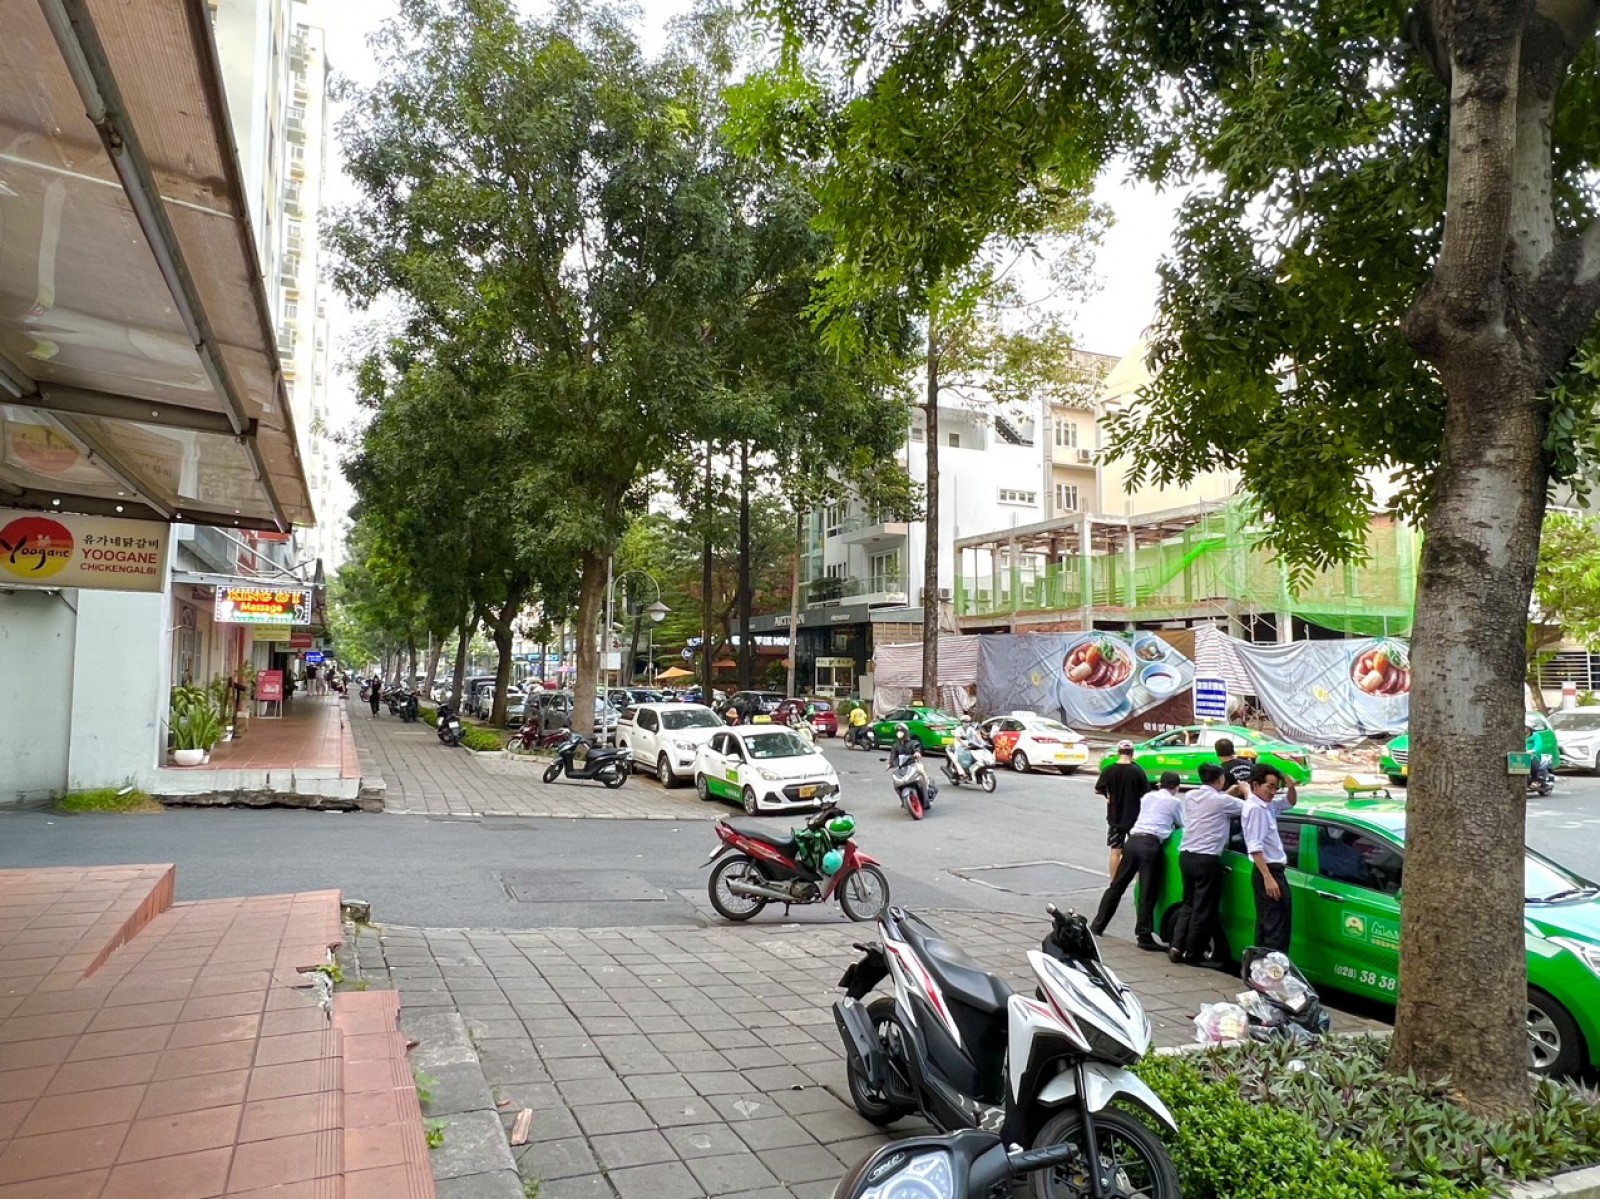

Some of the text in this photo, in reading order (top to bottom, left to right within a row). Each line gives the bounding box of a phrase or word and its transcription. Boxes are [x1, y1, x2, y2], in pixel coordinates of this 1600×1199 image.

[83, 533, 160, 550] 유가네닭갈비
[81, 548, 158, 564] YOOGANE
[79, 562, 157, 576] CHICKENGALBI
[228, 591, 273, 603] KING
[240, 602, 283, 614] Massage
[1359, 970, 1377, 986] 38
[1378, 976, 1397, 991] 38
